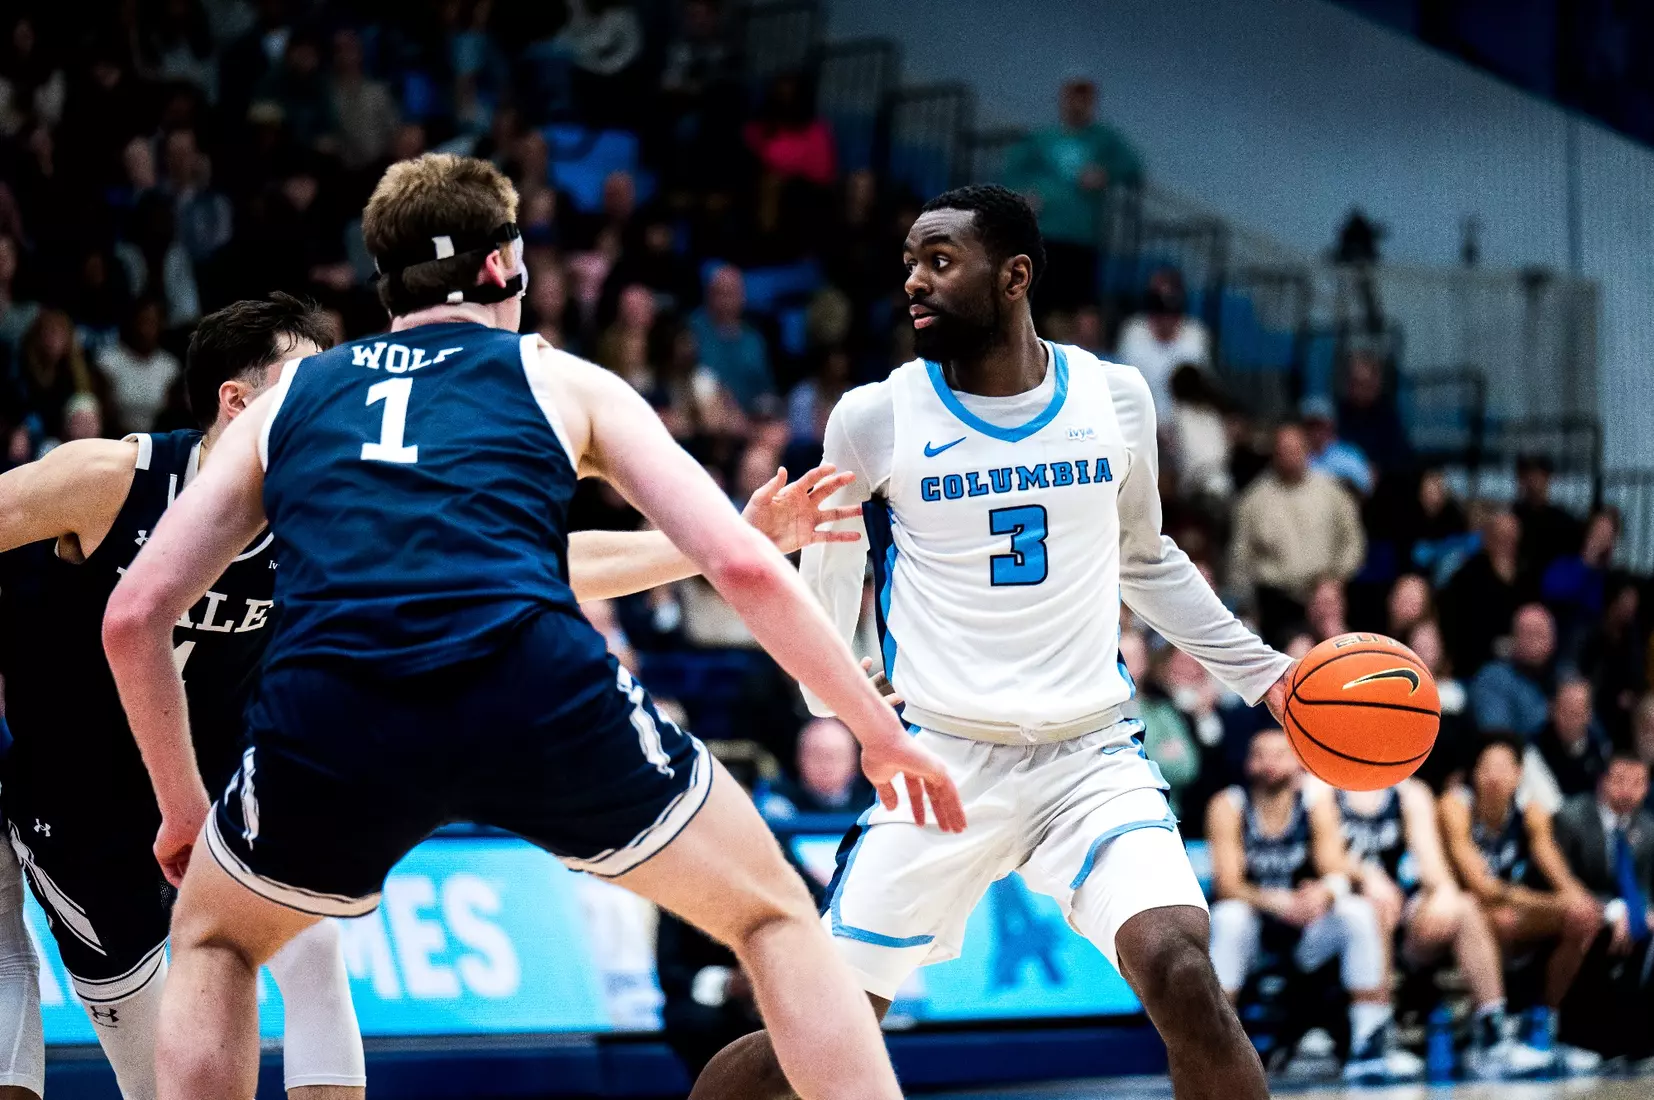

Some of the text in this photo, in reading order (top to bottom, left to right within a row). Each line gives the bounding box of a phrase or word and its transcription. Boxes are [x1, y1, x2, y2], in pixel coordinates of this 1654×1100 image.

[360, 377, 418, 464] 1
[921, 457, 1113, 502] COLUMBIA
[268, 559, 280, 570] Iv
[988, 504, 1049, 587] 3
